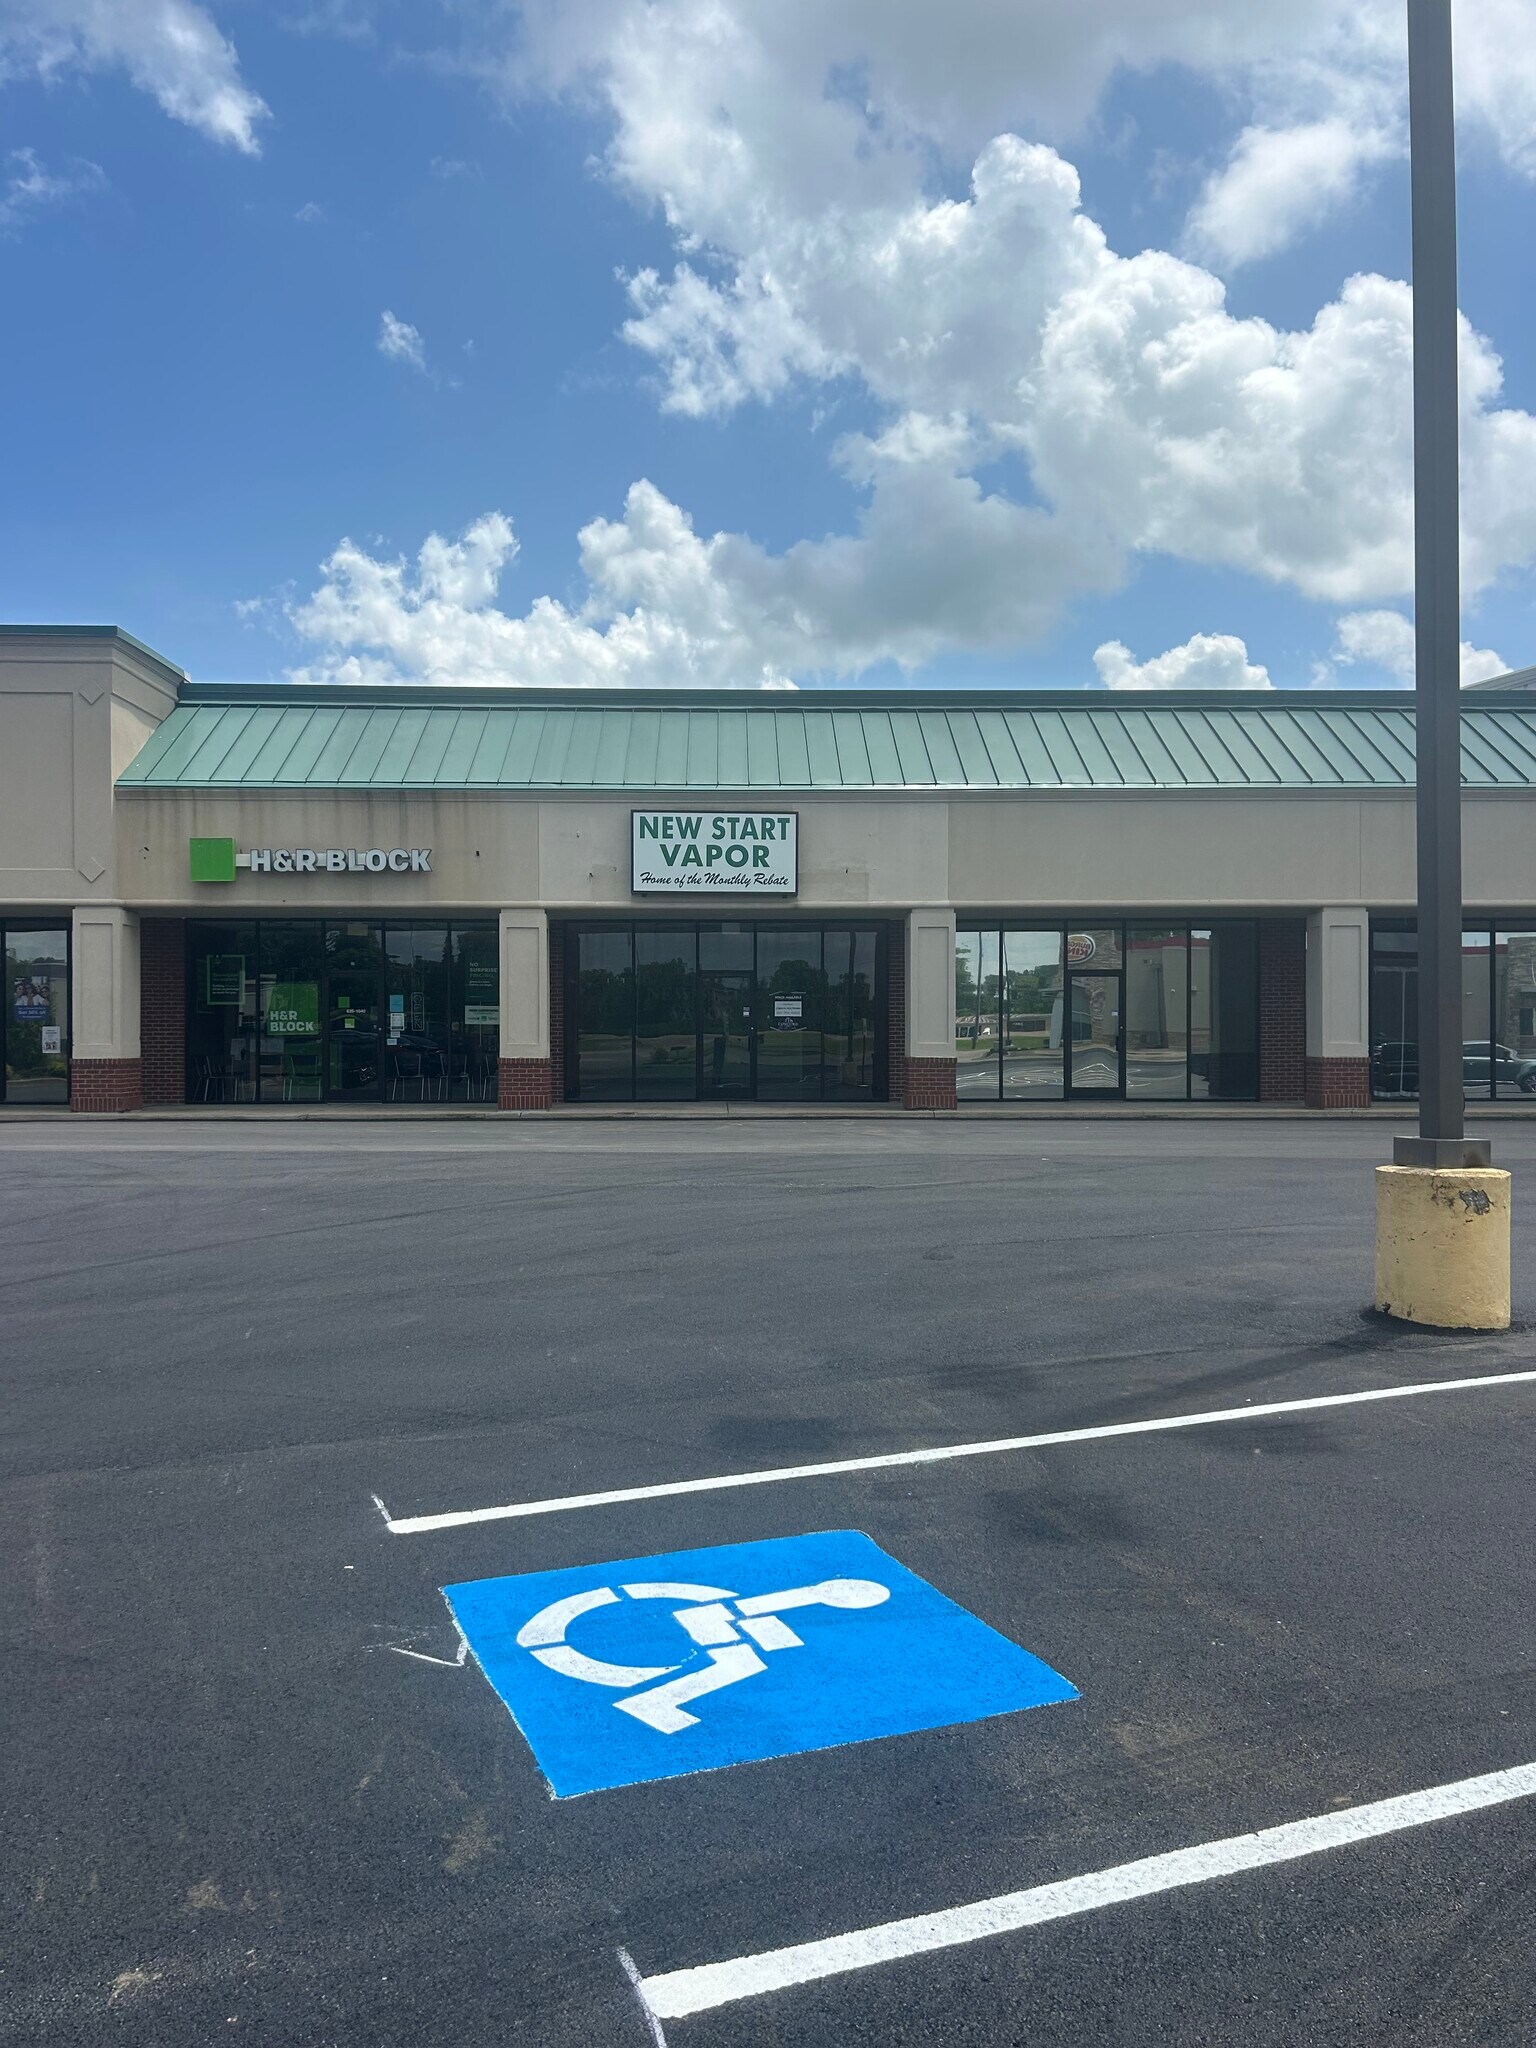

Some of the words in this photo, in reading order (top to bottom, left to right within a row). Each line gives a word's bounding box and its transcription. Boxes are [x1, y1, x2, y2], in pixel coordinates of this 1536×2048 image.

[639, 816, 703, 839] NEW
[711, 817, 791, 841] START
[250, 848, 318, 872] H&R
[326, 848, 432, 872] BLOCK
[659, 844, 770, 868] VAPOR
[640, 871, 672, 884] Home
[674, 874, 686, 888] of
[686, 872, 702, 885] the
[703, 872, 751, 888] Monthly
[753, 872, 790, 886] Rebate
[270, 1010, 298, 1021] H&R
[270, 1021, 315, 1032] BLOCK
